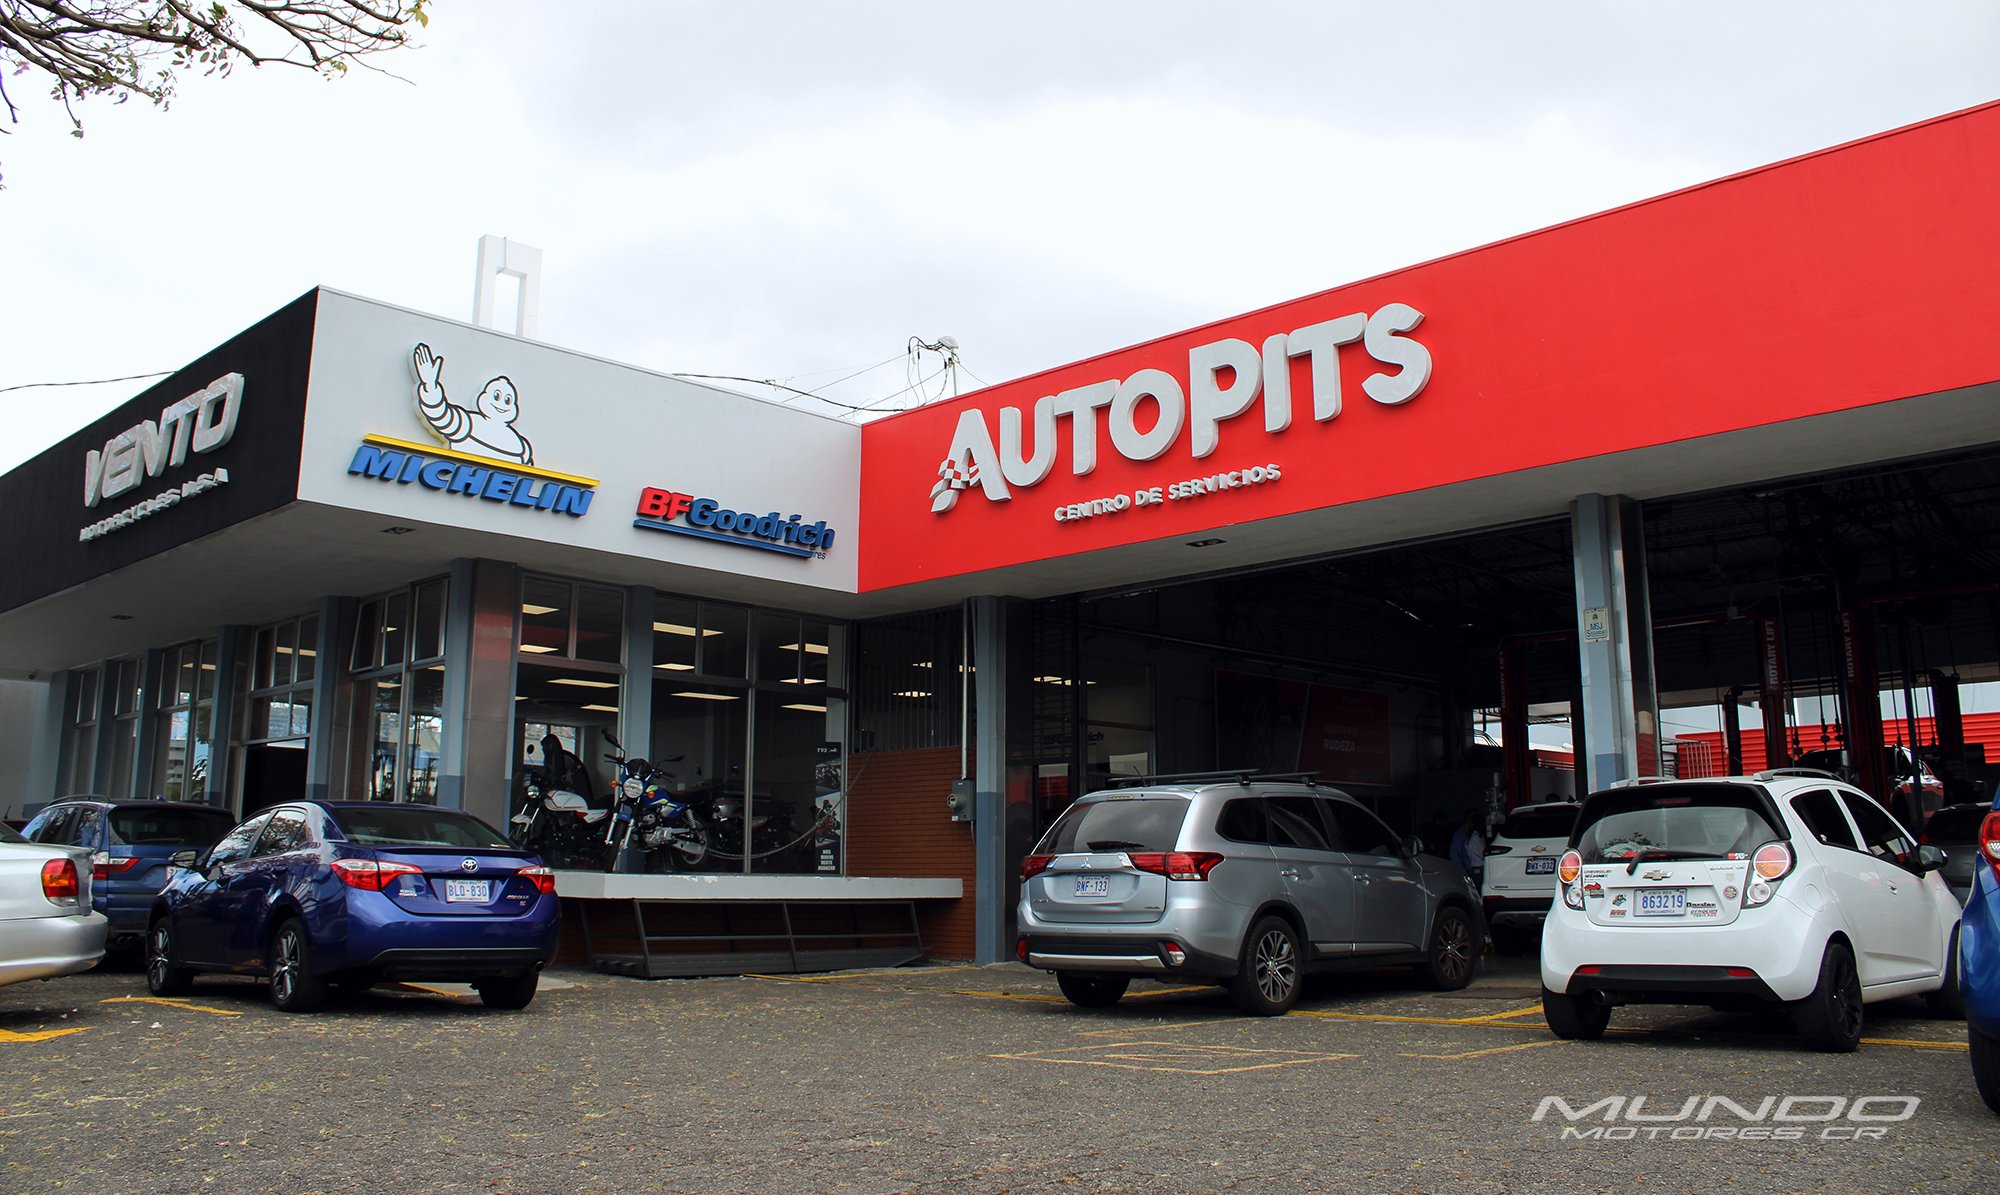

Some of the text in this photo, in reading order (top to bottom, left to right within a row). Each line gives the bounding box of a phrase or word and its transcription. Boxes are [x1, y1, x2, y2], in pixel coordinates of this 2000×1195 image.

[84, 372, 245, 508] VENTO
[931, 303, 1433, 513] AUTOPITS
[79, 467, 229, 542] MOTORCYCLES USA
[347, 444, 595, 517] MICHELIN
[1054, 463, 1282, 523] CENTRO DE SERVICIOS
[636, 486, 836, 549] BFGoodrich
[1765, 618, 1779, 685] ROTARY LIFT
[1842, 612, 1855, 678] ROTARY LIFT
[1323, 738, 1356, 752] RUDEZA
[1076, 880, 1108, 892] BNF-133
[1642, 894, 1683, 909] 863219
